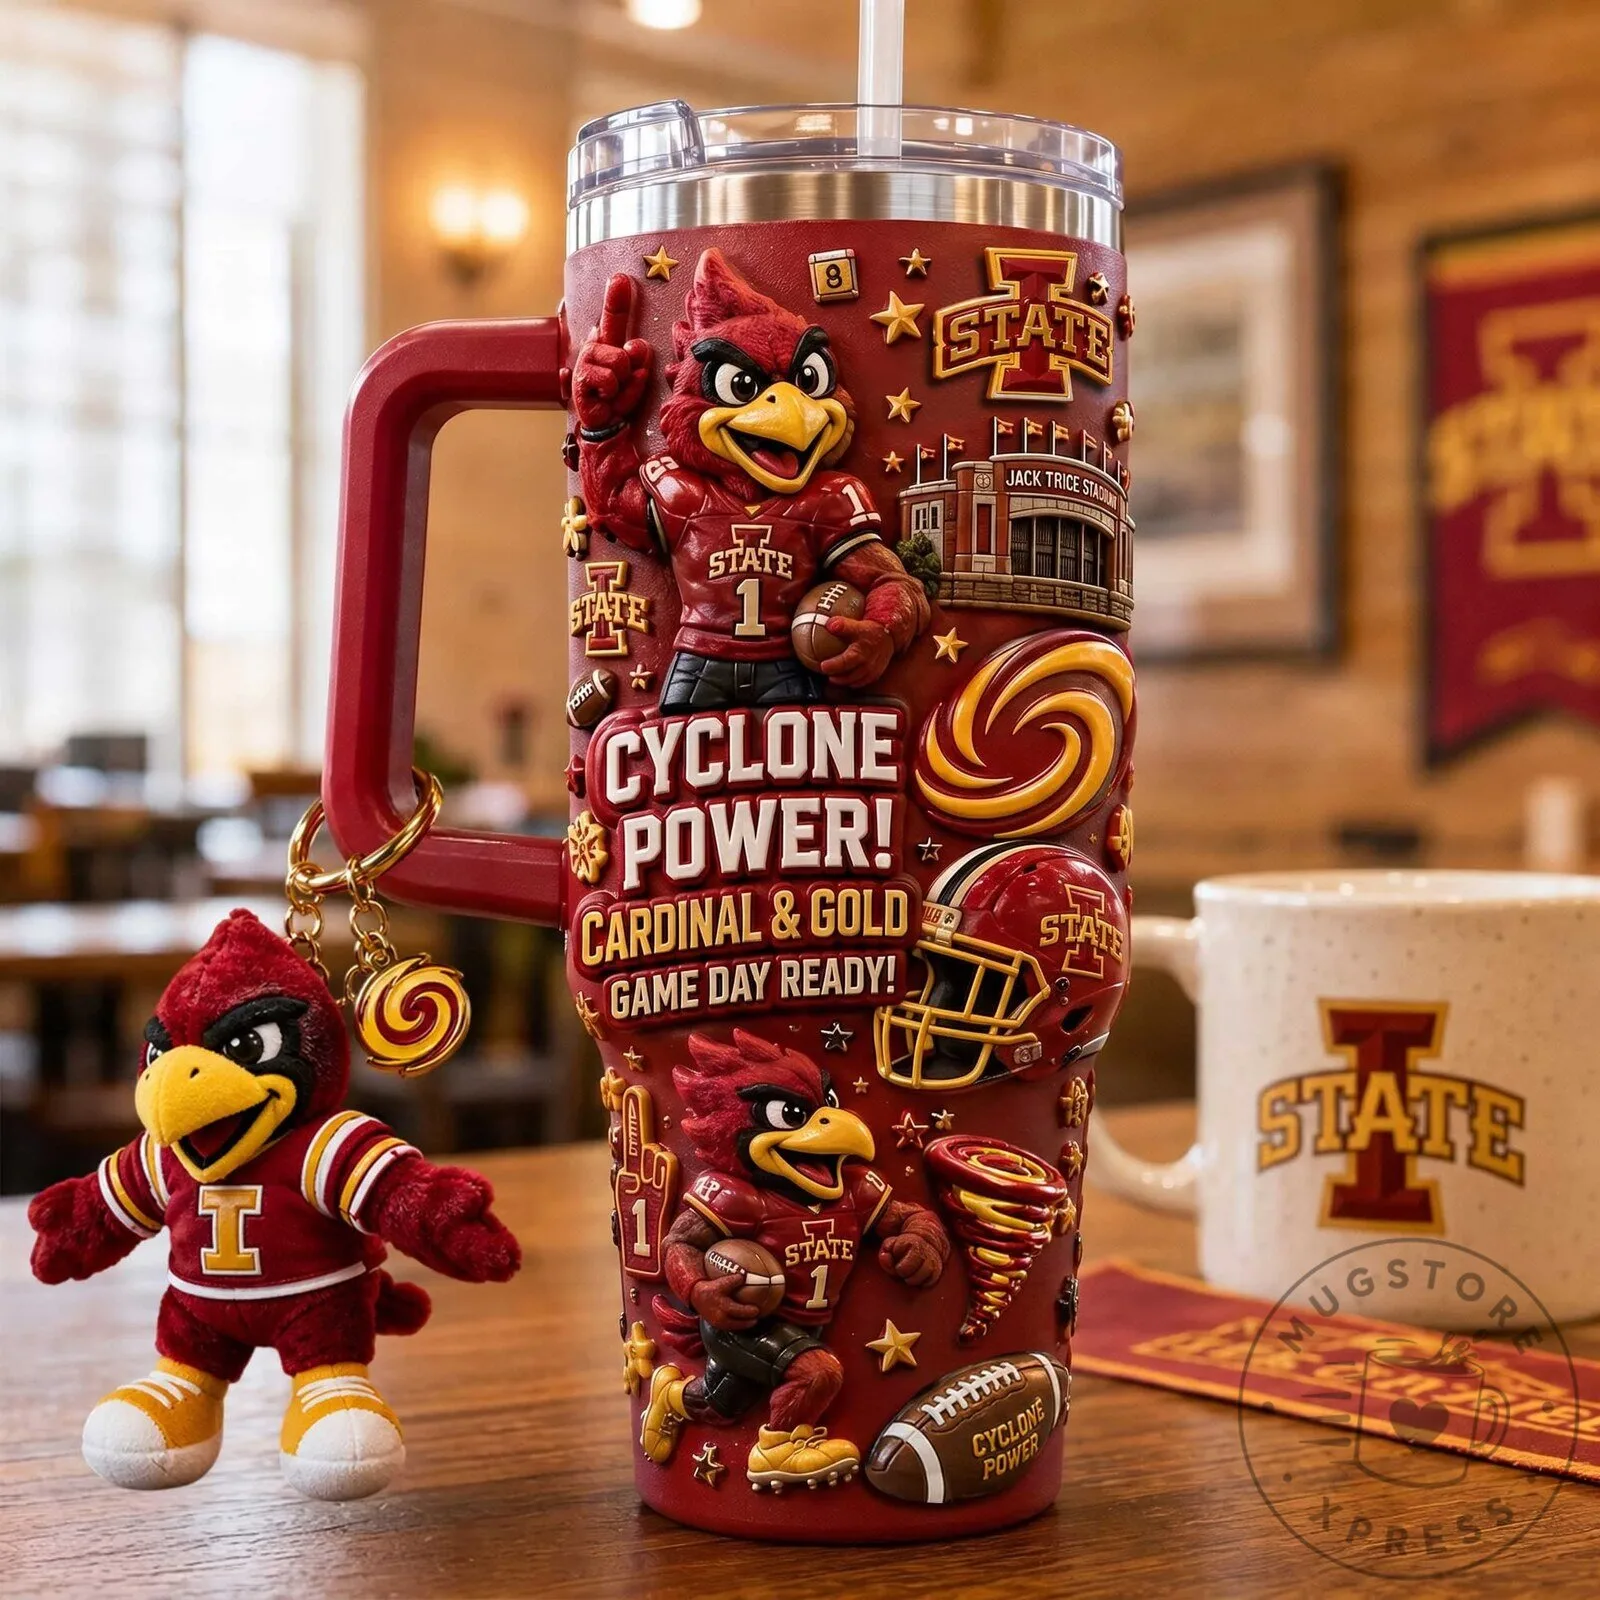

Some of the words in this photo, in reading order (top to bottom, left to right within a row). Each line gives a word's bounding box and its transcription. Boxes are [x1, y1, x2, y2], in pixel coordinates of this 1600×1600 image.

[826, 264, 843, 288] 8
[949, 303, 1113, 363] STATE
[1005, 470, 1042, 487] JACK
[1045, 471, 1080, 493] TRICE
[708, 547, 793, 580] STATE
[570, 591, 650, 636] STATE
[734, 578, 766, 636] 1
[605, 711, 899, 806] CYCLONE
[622, 797, 895, 891] POWER!
[581, 892, 763, 967] CARDINAL
[771, 889, 801, 940] &
[810, 888, 909, 938] GOLD
[1039, 913, 1124, 965] STATE
[610, 969, 700, 1021] GAME
[708, 962, 771, 1006] DAY
[780, 955, 896, 999] READY!
[1256, 1070, 1527, 1188] STATE
[198, 1185, 263, 1277] I
[631, 1198, 652, 1257] 1
[784, 1239, 854, 1268] STATE
[805, 1264, 829, 1309] 1
[972, 1396, 1046, 1458] CYCLONE
[982, 1432, 1040, 1481] POWER
